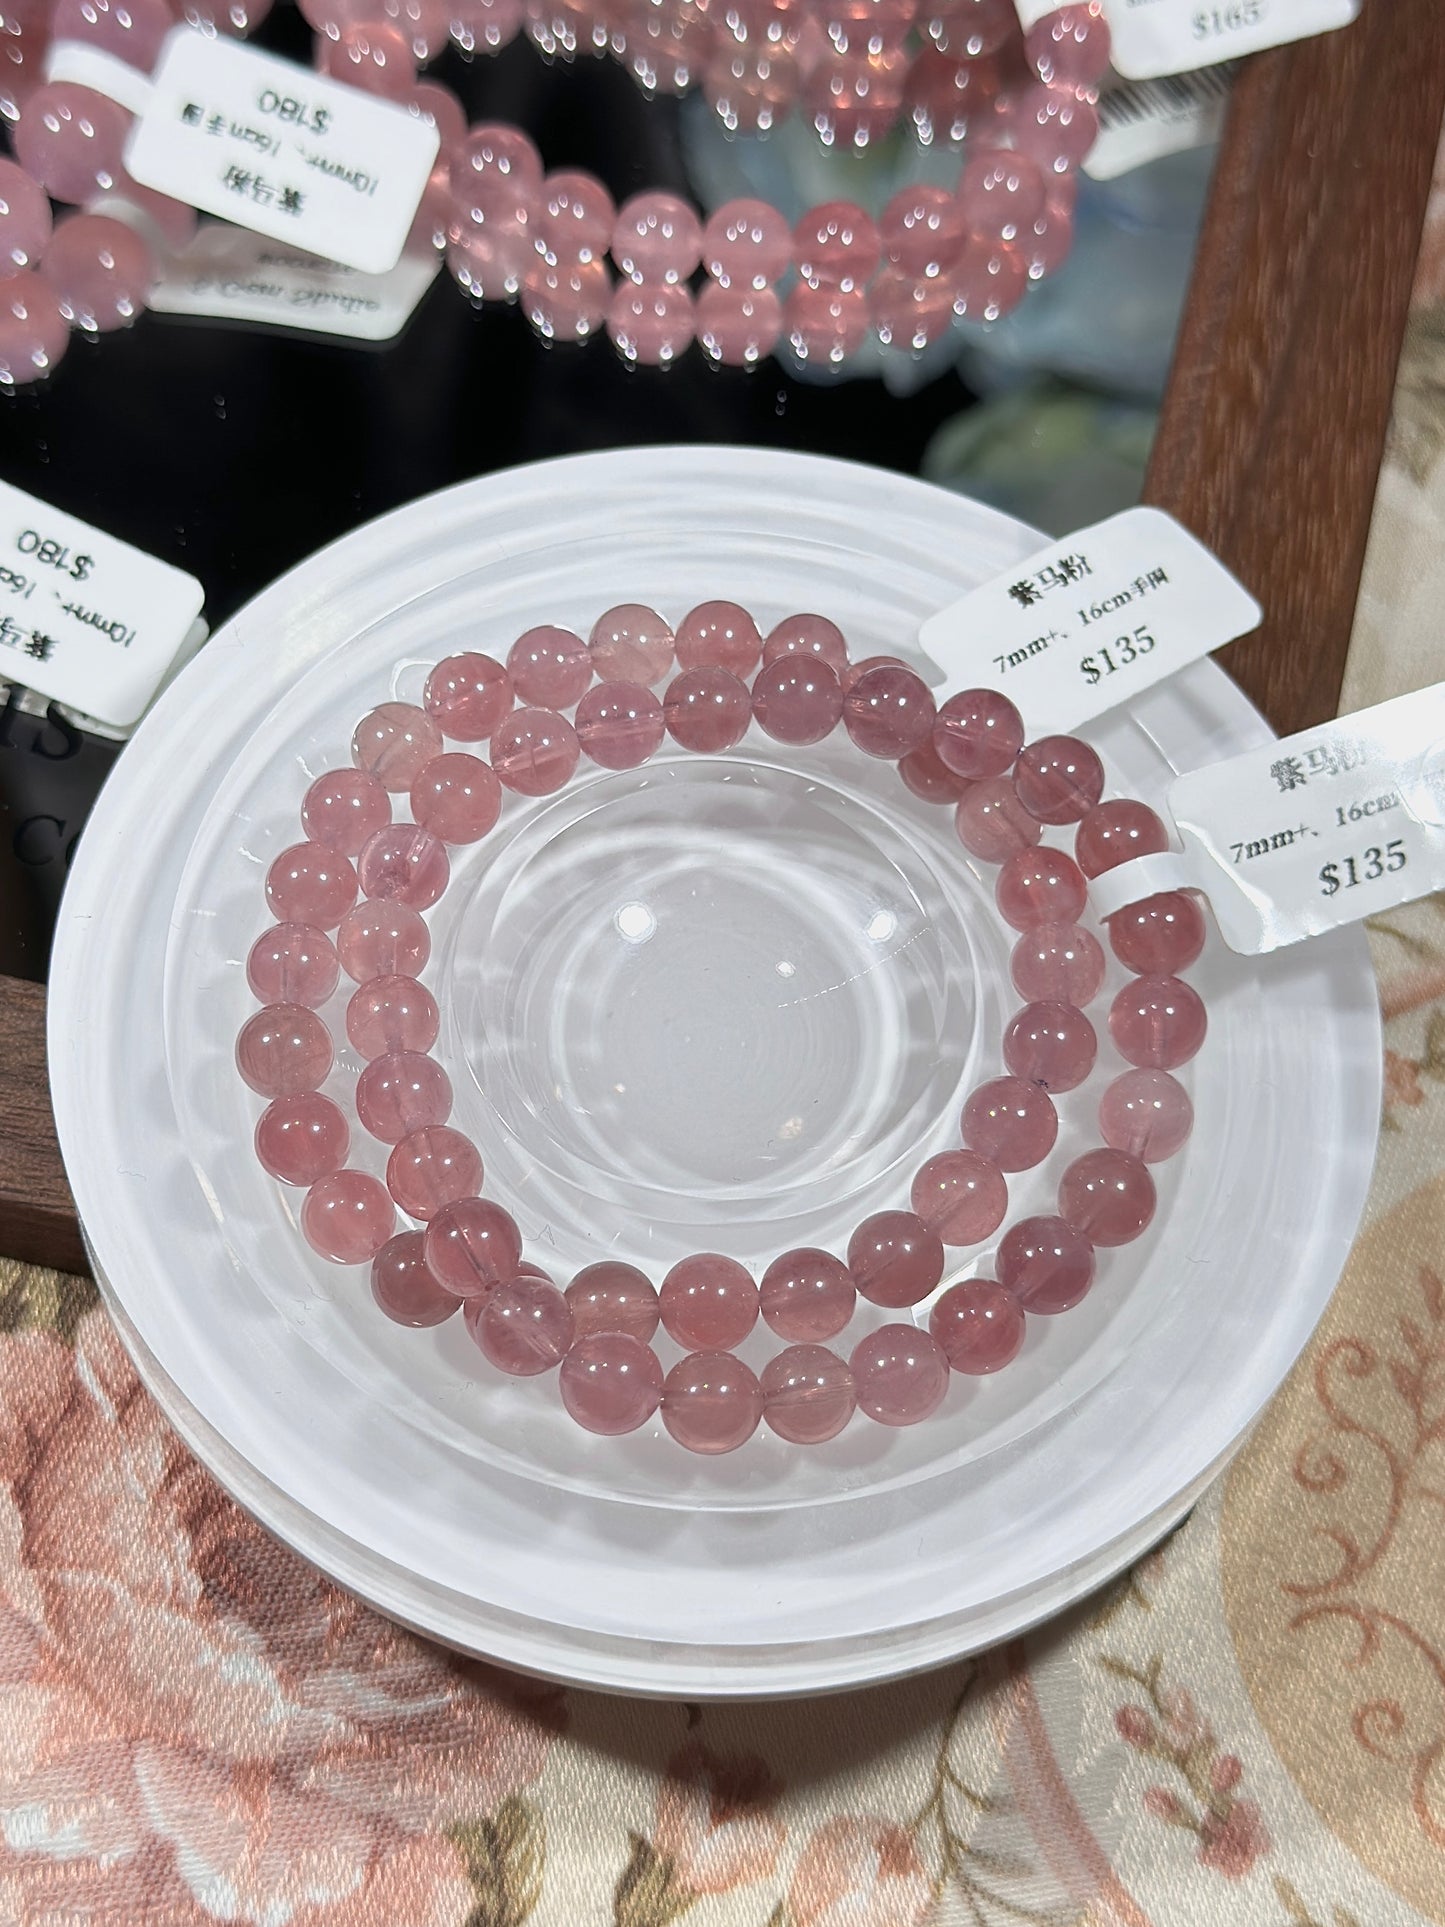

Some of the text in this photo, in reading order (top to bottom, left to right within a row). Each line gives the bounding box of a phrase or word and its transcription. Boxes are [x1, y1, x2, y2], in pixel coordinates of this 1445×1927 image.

[259, 89, 331, 135] $180
[16, 529, 96, 583] $180
[1007, 553, 1093, 610] 紫马粉
[1079, 624, 1156, 686] $135
[1318, 839, 1408, 898] $135
